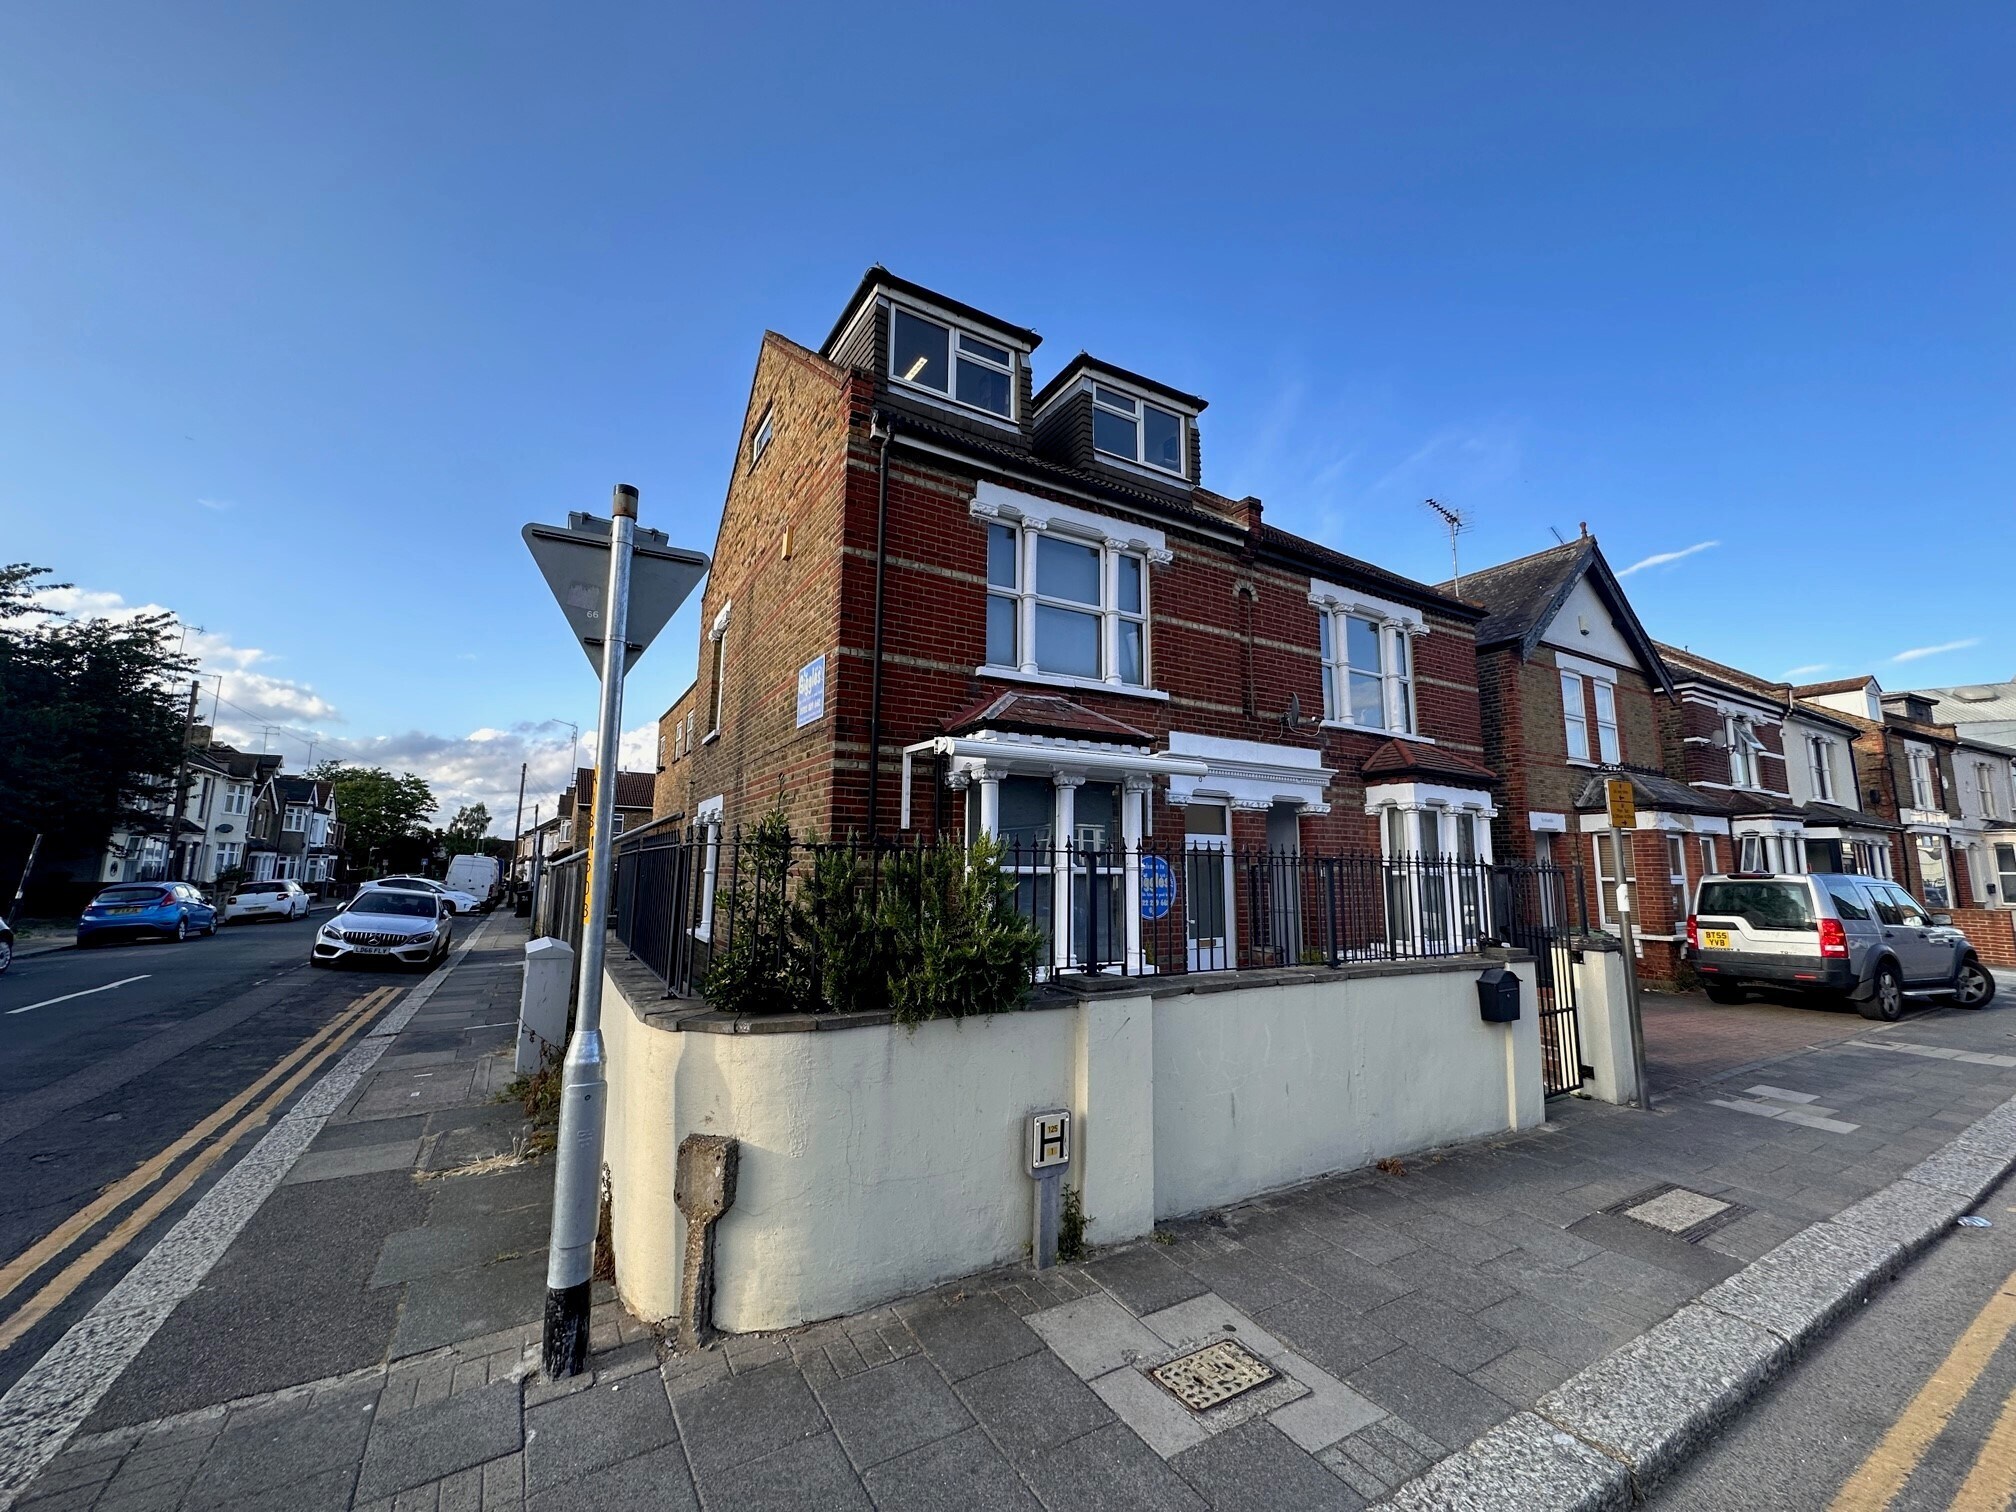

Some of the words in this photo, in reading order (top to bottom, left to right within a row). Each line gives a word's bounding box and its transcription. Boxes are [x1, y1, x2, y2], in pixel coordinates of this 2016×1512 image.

[586, 610, 599, 618] 66
[1705, 931, 1727, 939] BT55
[1709, 939, 1725, 947] YVB
[1047, 1125, 1059, 1133] 125
